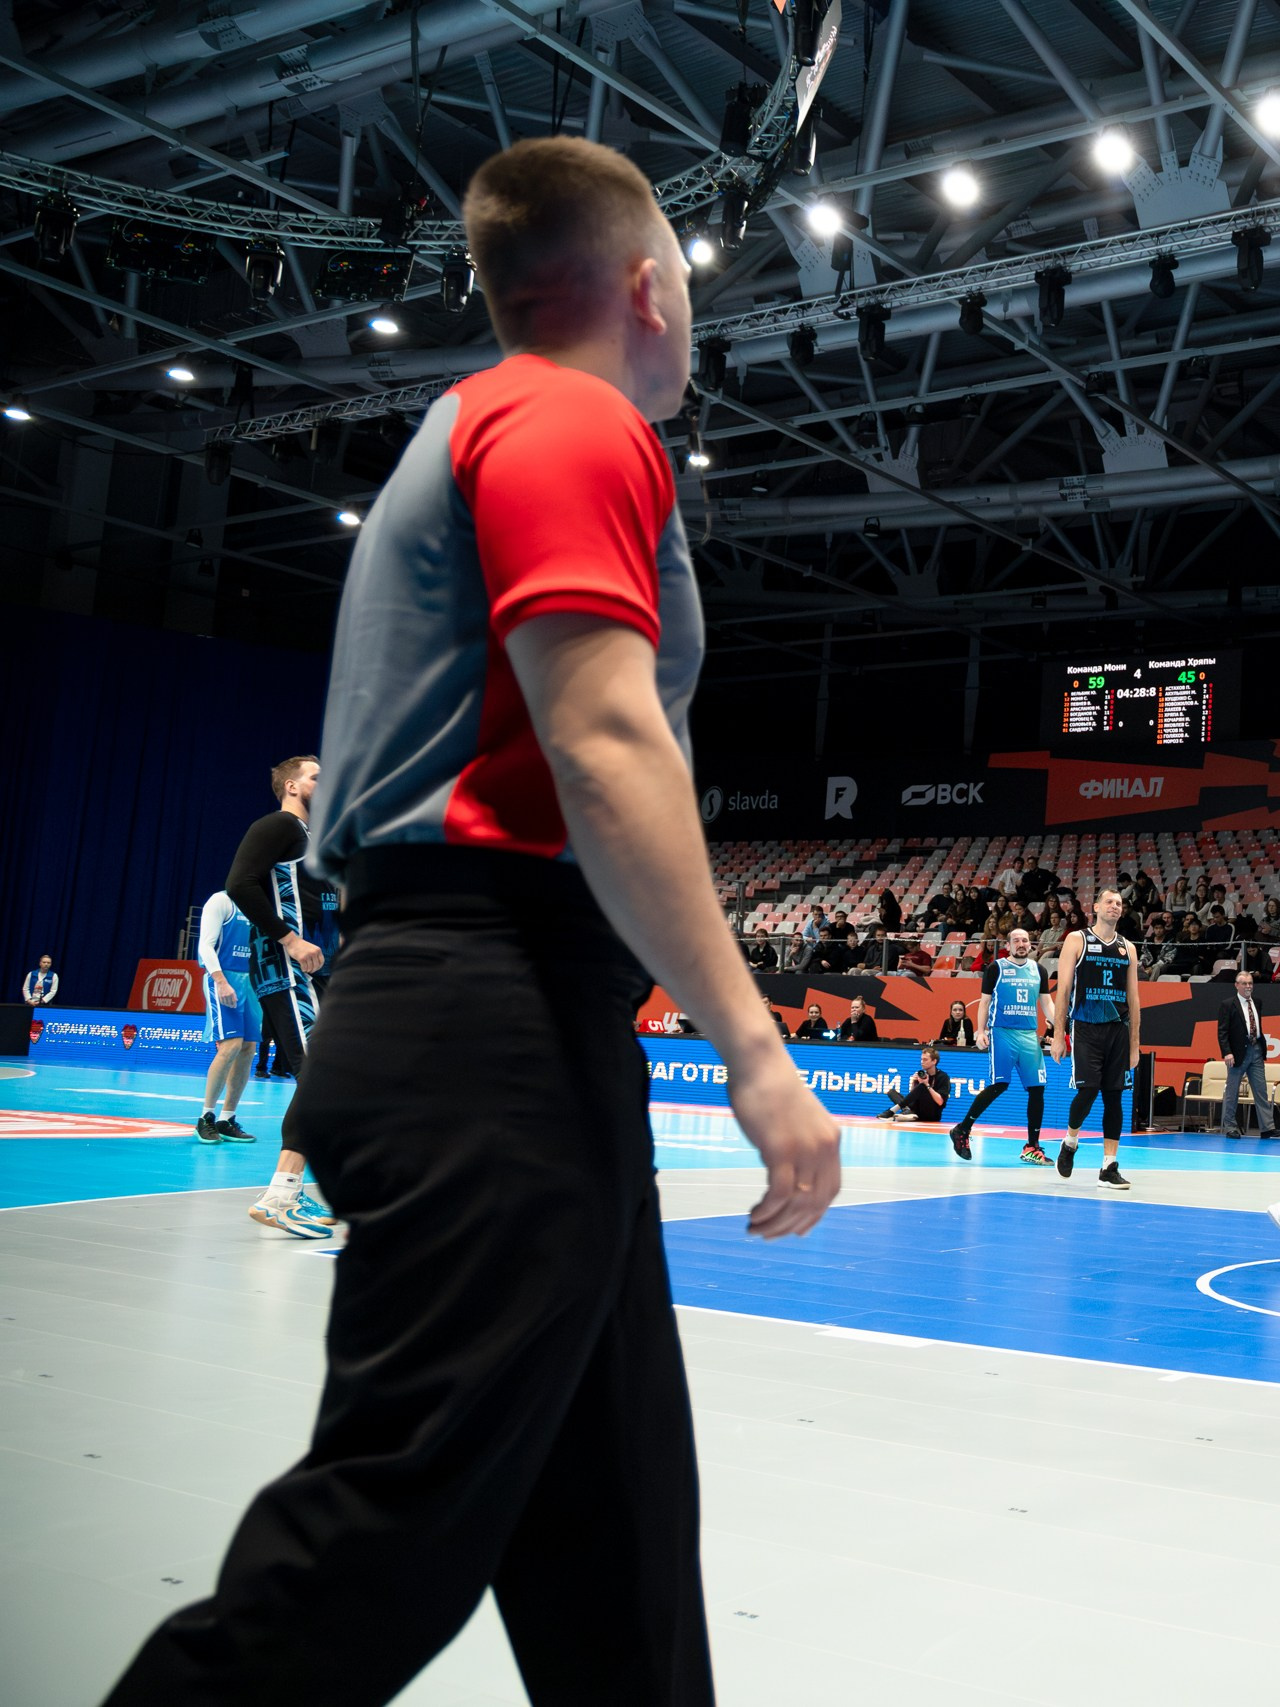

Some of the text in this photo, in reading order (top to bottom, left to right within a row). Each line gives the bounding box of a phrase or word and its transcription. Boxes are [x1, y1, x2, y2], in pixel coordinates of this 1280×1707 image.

[1067, 663, 1127, 674] Команда Мони
[1148, 657, 1216, 668] Команда Хряпы
[1133, 669, 1142, 679] 4
[1177, 671, 1196, 684] 45
[1199, 672, 1206, 680] 0
[1073, 680, 1080, 688] 0
[1088, 676, 1105, 689] 59
[1116, 687, 1157, 699] 04:28:8
[1079, 777, 1164, 799] ФИНАЛ
[728, 789, 778, 811] slavda
[1103, 969, 1113, 986] 12
[152, 978, 183, 998] КУБОК
[1016, 988, 1029, 1003] 63
[45, 1022, 87, 1036] СОХРАНИ
[138, 1027, 180, 1041] СОХРАНИ
